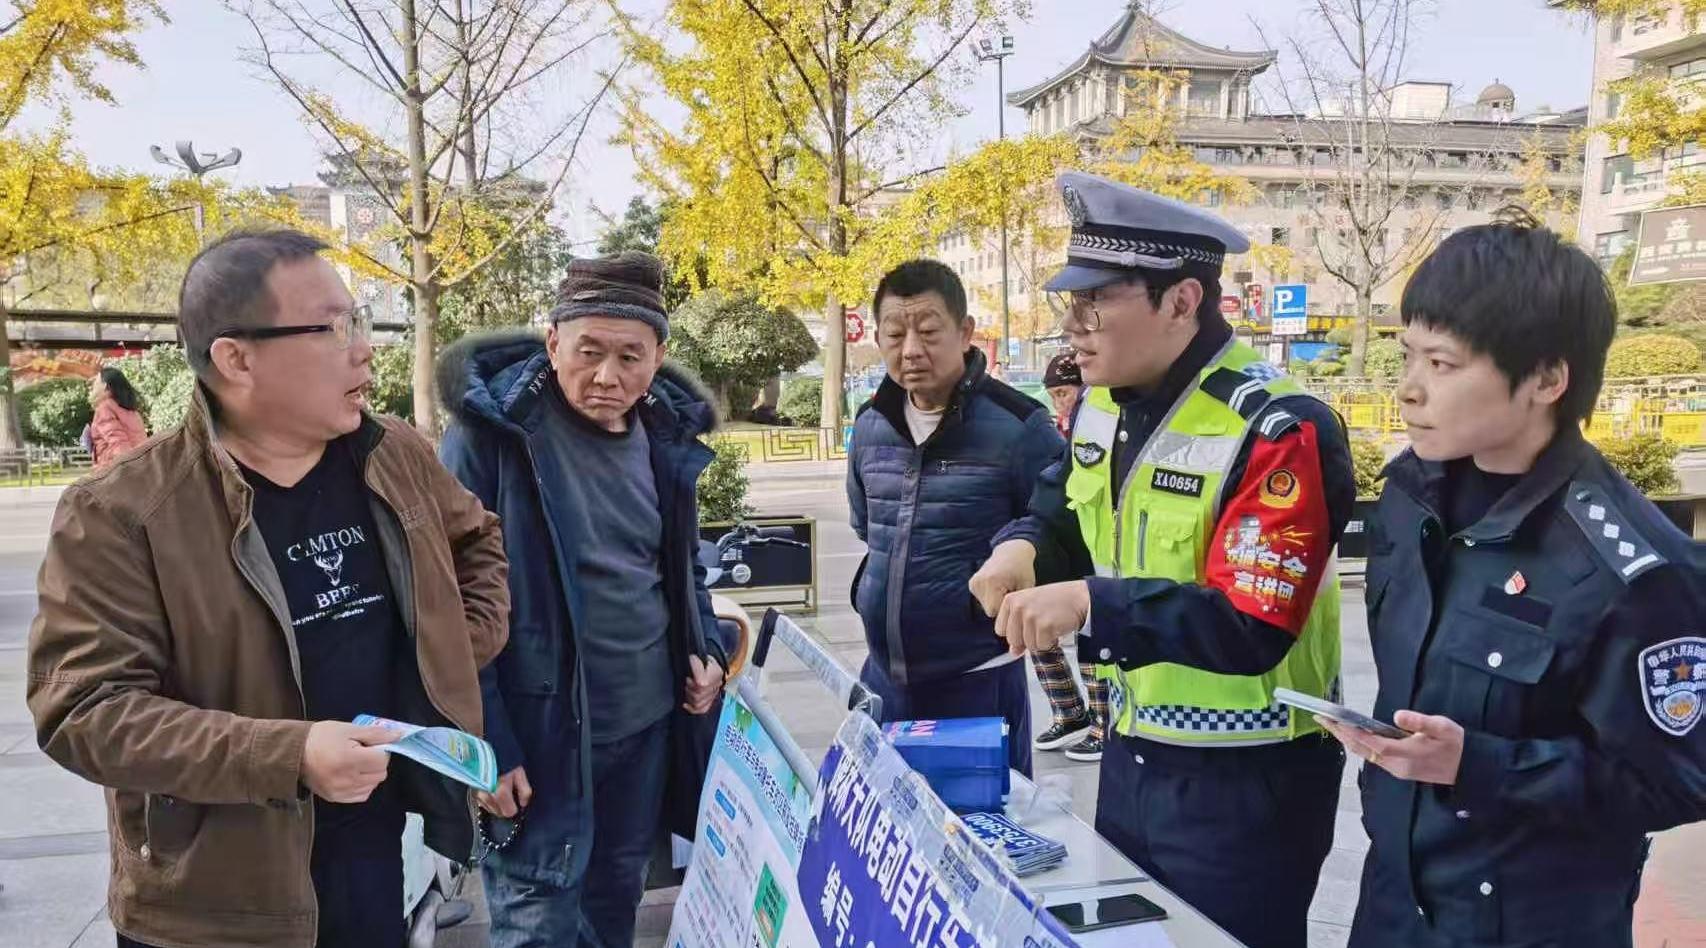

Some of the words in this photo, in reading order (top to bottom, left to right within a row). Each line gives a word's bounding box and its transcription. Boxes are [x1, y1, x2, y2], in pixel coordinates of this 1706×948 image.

[1275, 289, 1294, 314] P
[1154, 471, 1199, 492] XA0654
[287, 525, 365, 561] CMTON
[1233, 570, 1295, 600] 宣讲团
